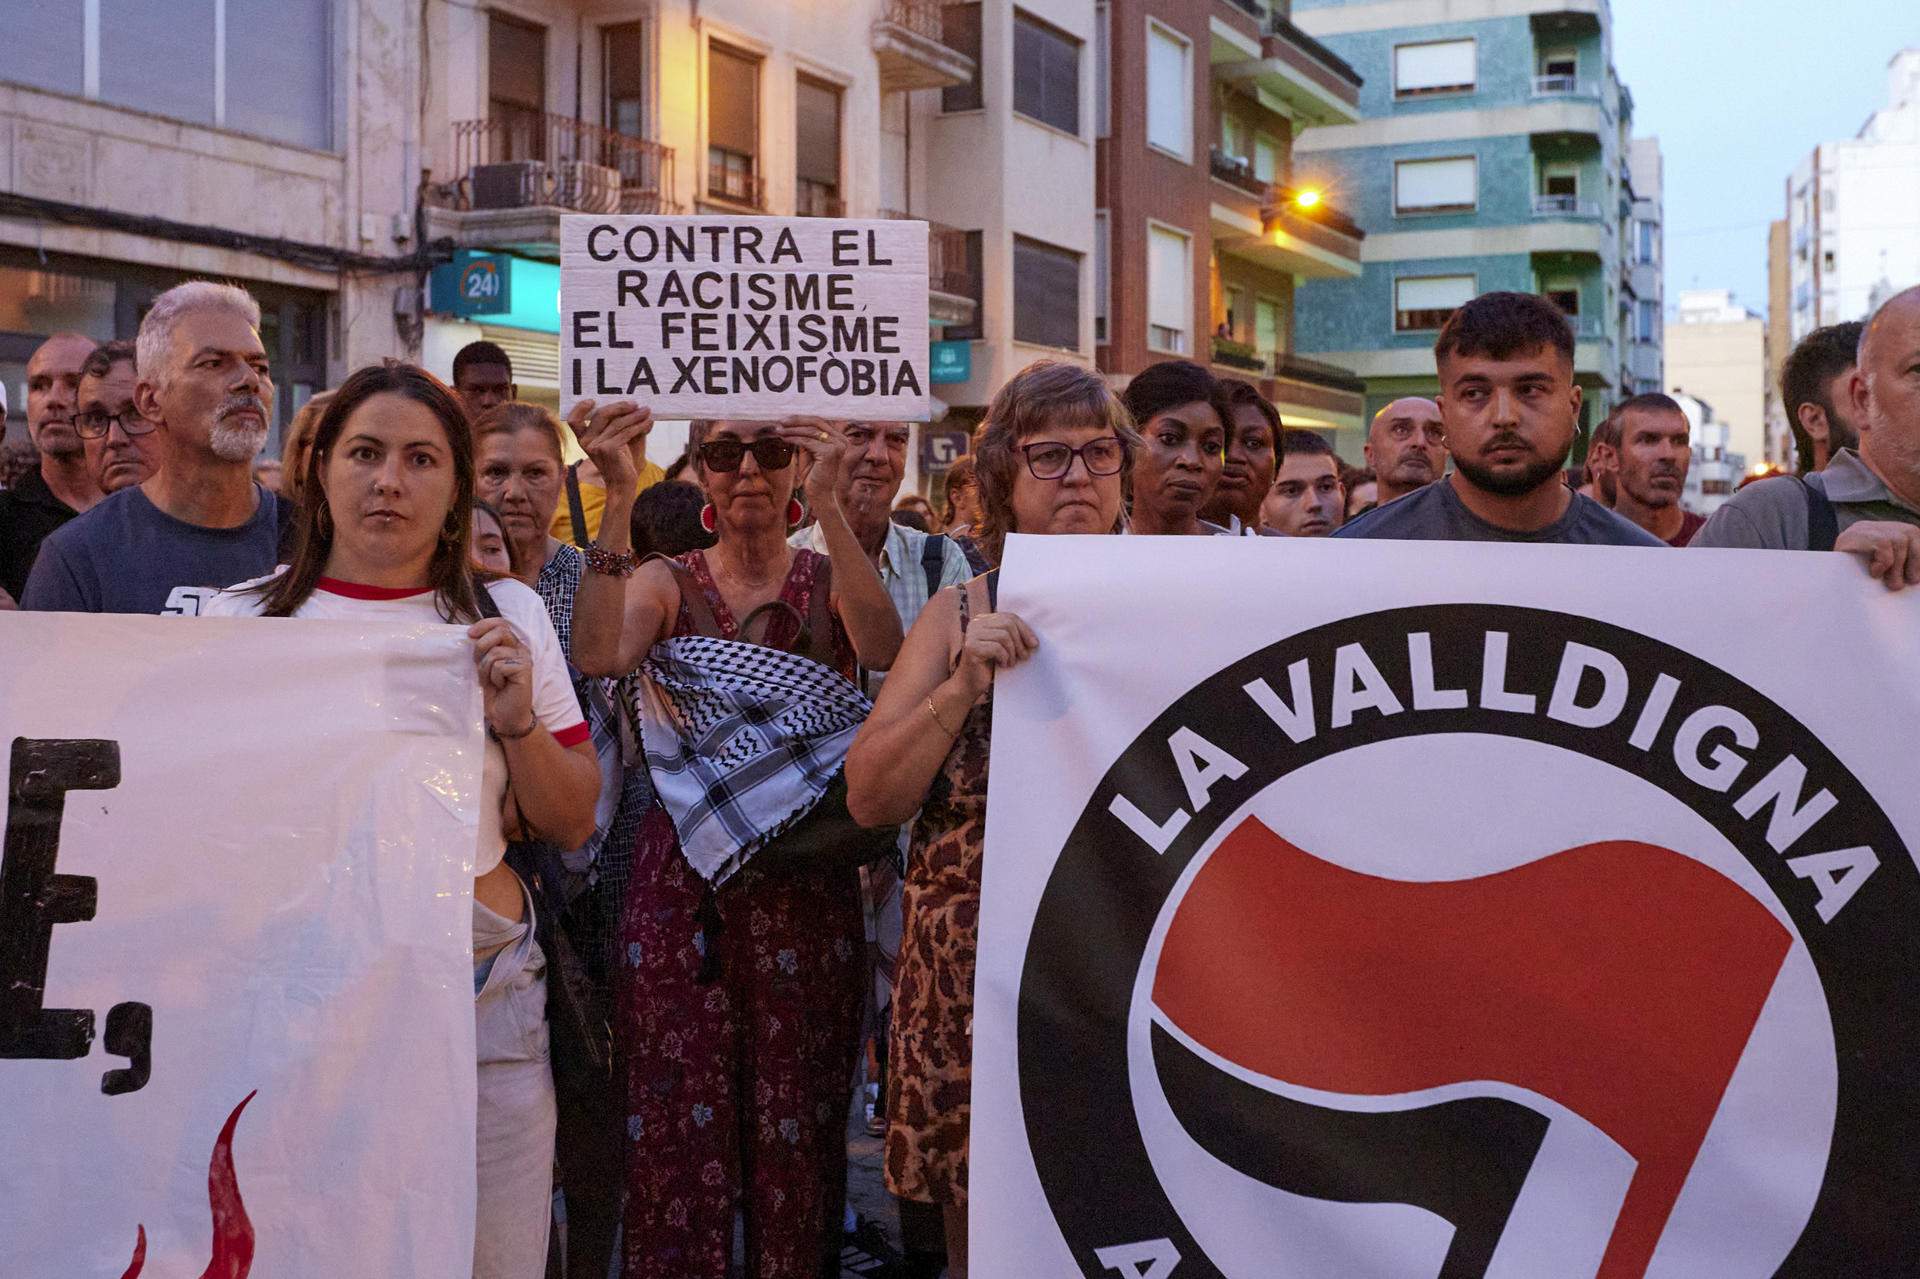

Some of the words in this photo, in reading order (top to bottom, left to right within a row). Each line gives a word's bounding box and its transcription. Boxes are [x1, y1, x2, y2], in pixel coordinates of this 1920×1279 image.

[587, 225, 803, 264] CONTRA
[832, 229, 893, 267] EL
[572, 310, 634, 349] EL
[660, 311, 901, 354] FEIXISME
[572, 358, 583, 396] I
[596, 357, 661, 395] LA
[669, 351, 923, 397] XENOFÒBIA
[1108, 725, 1250, 855] LA
[1242, 630, 1881, 924] VALLDIGNA
